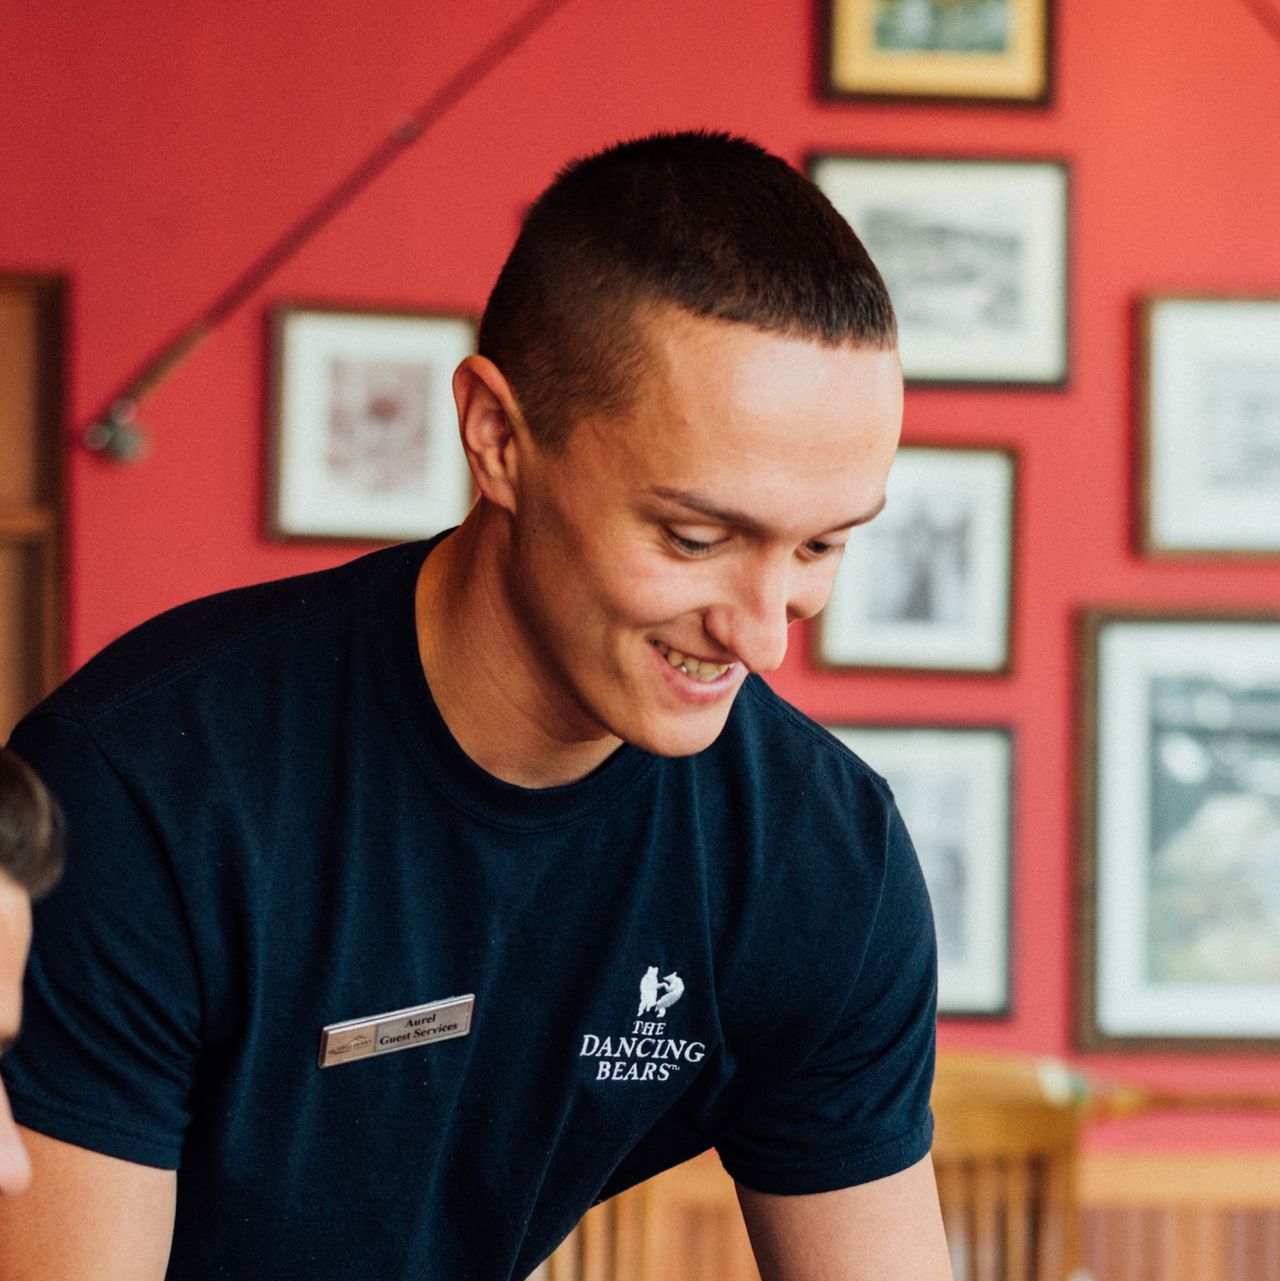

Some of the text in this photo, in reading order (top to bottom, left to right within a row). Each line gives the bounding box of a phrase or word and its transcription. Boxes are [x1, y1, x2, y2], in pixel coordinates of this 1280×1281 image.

[404, 1013, 437, 1029] Aurel
[631, 1020, 667, 1036] THE
[379, 1033, 412, 1046] Guest
[413, 1022, 458, 1039] Services
[579, 1033, 706, 1063] DANCING
